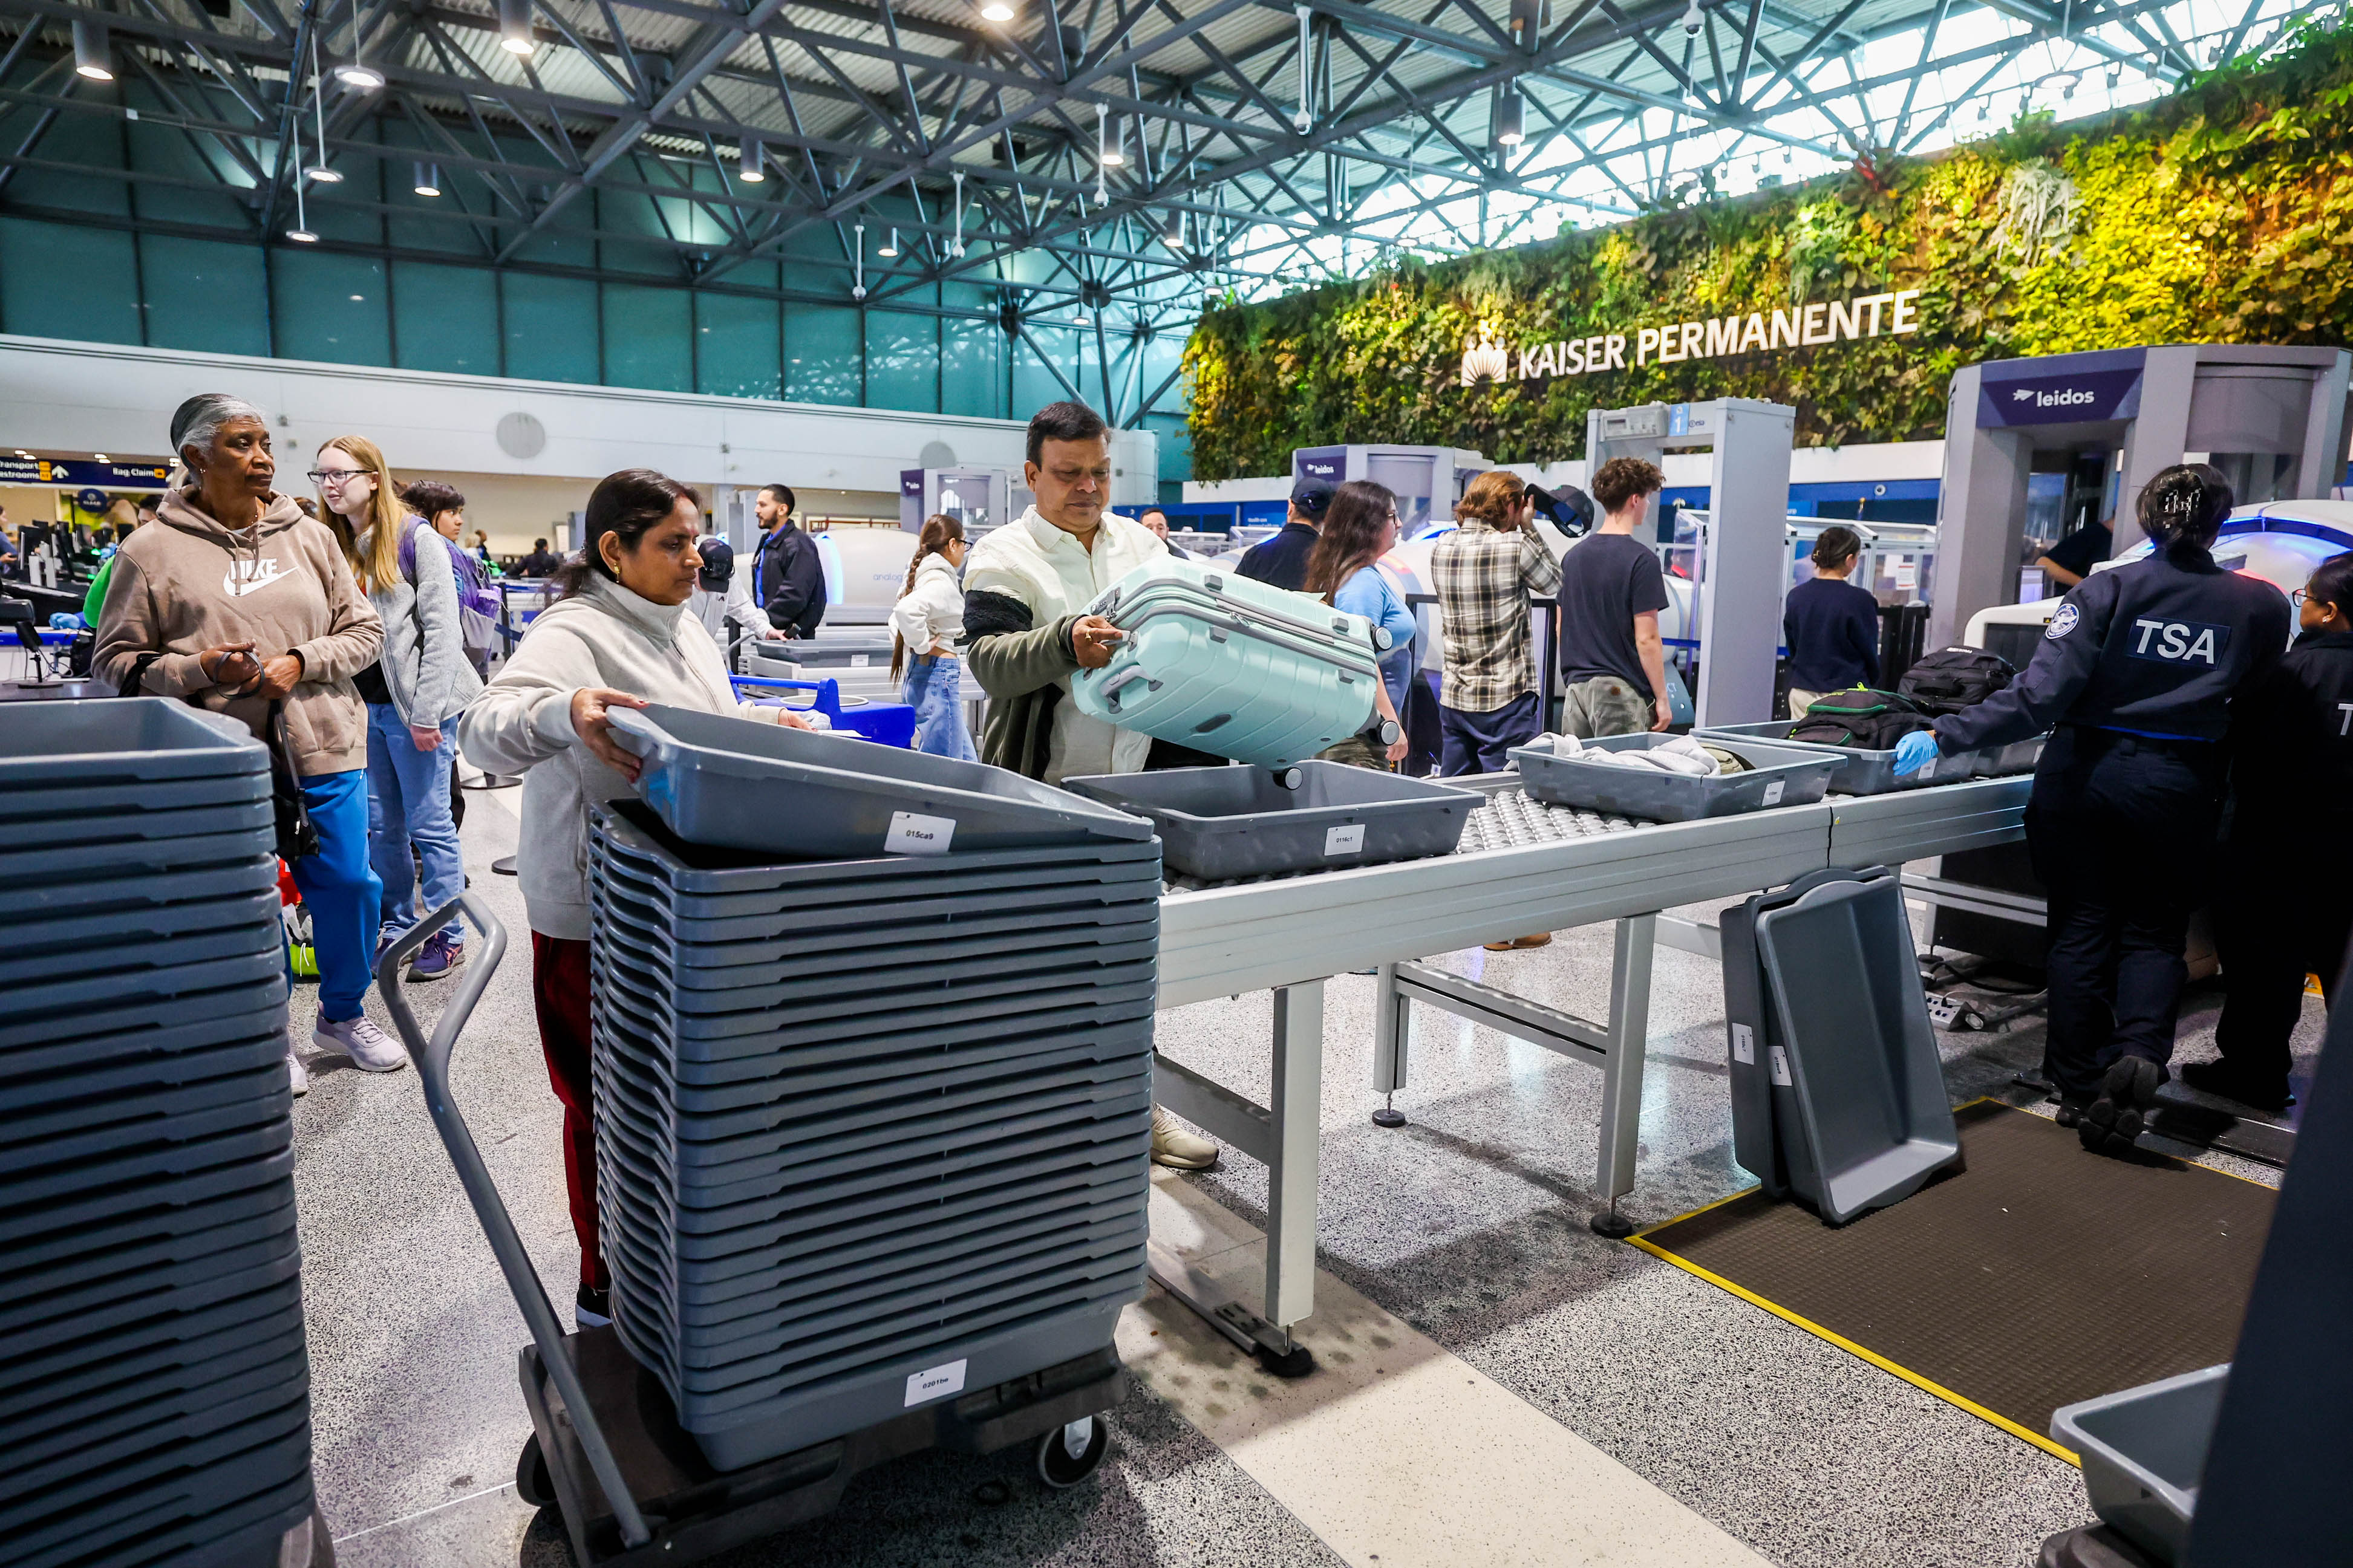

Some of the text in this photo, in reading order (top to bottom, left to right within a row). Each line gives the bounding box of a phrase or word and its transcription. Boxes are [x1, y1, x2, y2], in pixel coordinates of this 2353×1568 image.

[1518, 289, 1921, 380] KAISER PERMANENTE
[2037, 388, 2095, 407] leidos
[1674, 416, 1682, 433] 1
[0, 460, 39, 470] ransport
[113, 467, 154, 478] Bag Claim
[1314, 464, 1334, 474] leidos
[230, 558, 277, 581] NIKE
[2136, 619, 2214, 664] TSA
[906, 830, 934, 840] 015ca9
